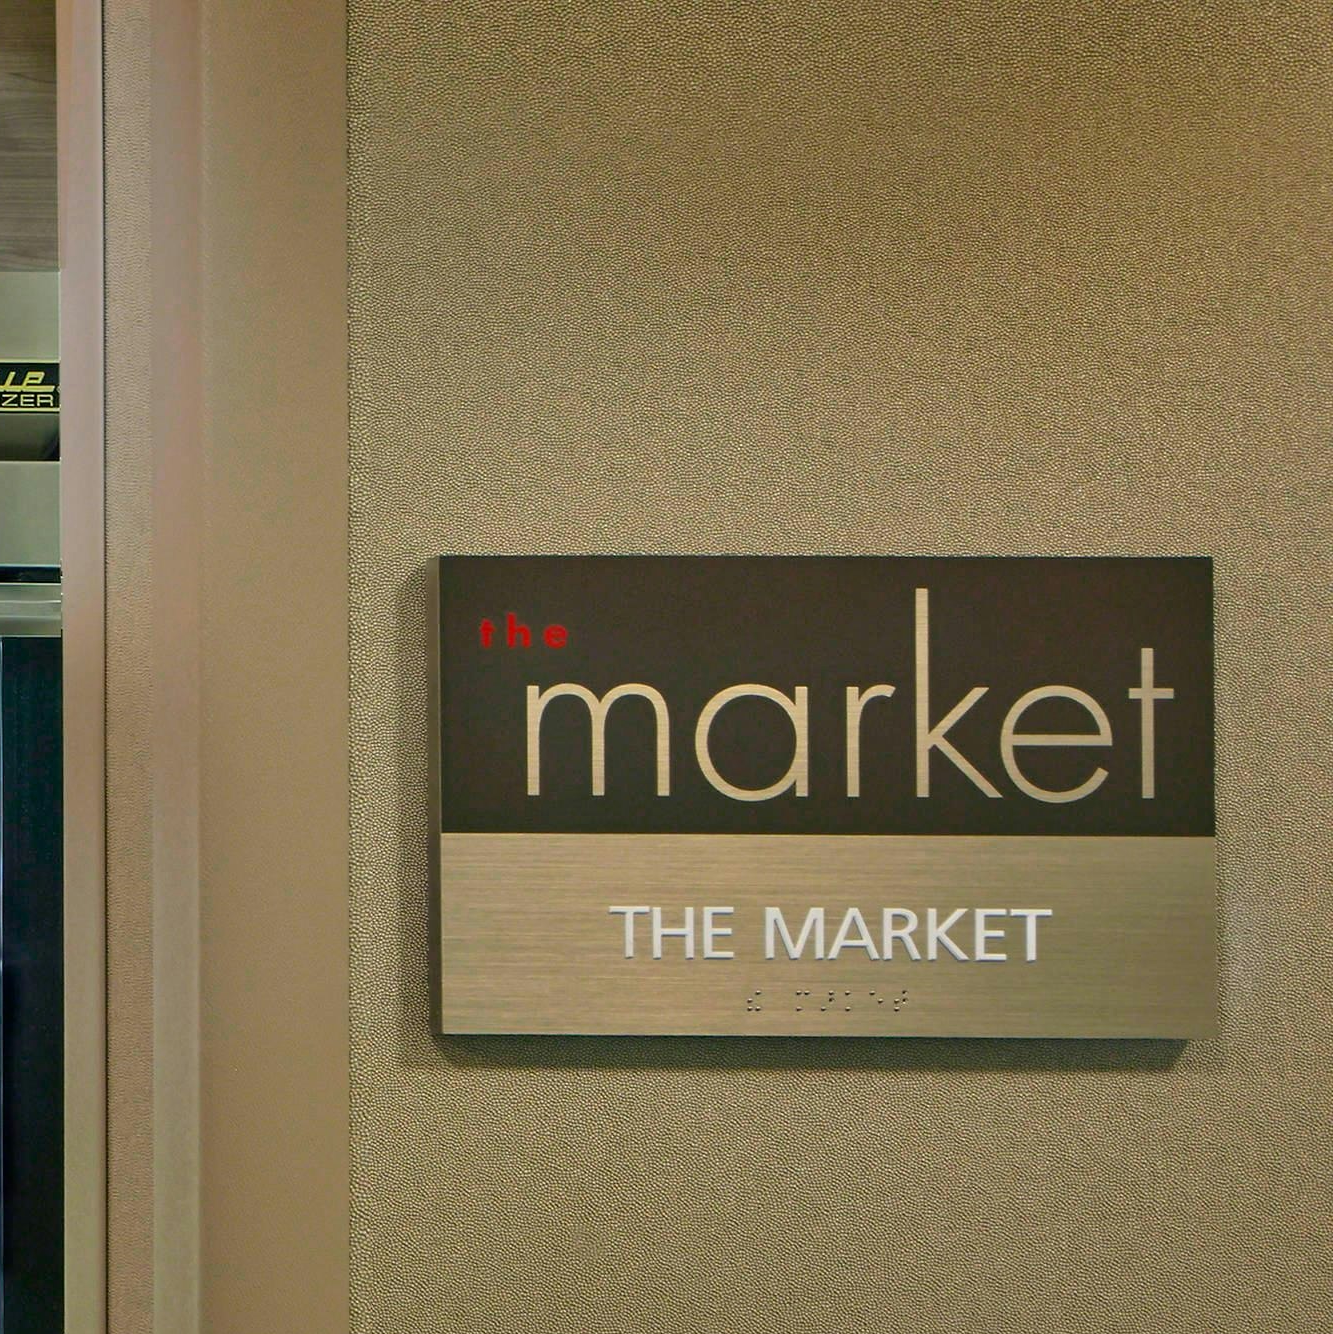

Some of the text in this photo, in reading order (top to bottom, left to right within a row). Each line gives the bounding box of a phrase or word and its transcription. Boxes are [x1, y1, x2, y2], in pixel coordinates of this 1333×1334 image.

[480, 614, 569, 648] the
[526, 588, 1175, 801] market
[608, 905, 1053, 962] THE MARKET
